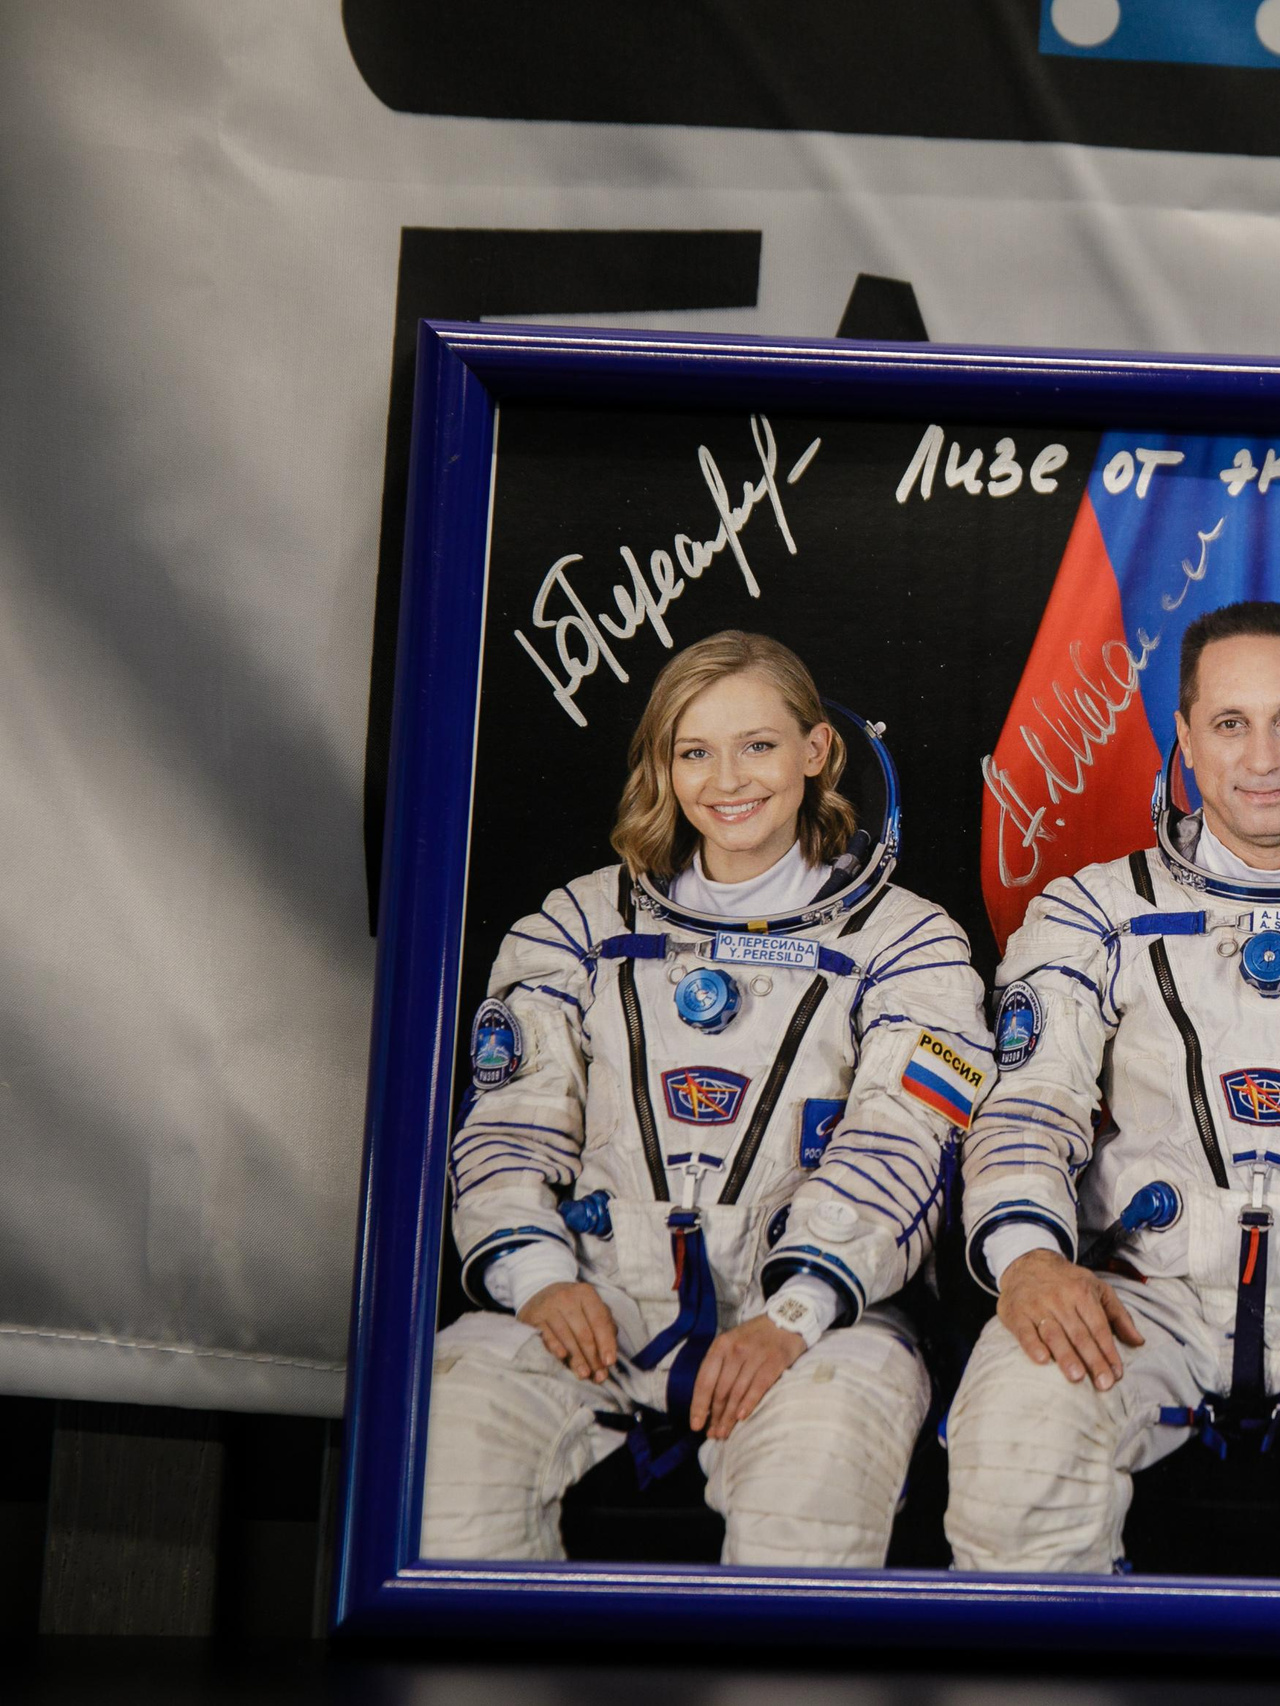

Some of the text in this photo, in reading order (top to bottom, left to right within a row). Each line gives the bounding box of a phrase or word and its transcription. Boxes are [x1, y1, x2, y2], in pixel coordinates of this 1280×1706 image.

[896, 424, 1070, 504] Лизе
[1103, 447, 1185, 499] от
[1261, 910, 1272, 919] А.
[1260, 920, 1270, 929] A.
[720, 935, 815, 956] Ю. ПЕРЕСИЛЬД
[729, 947, 804, 963] Y. PERESILD
[920, 1034, 982, 1087] РОССИЯ
